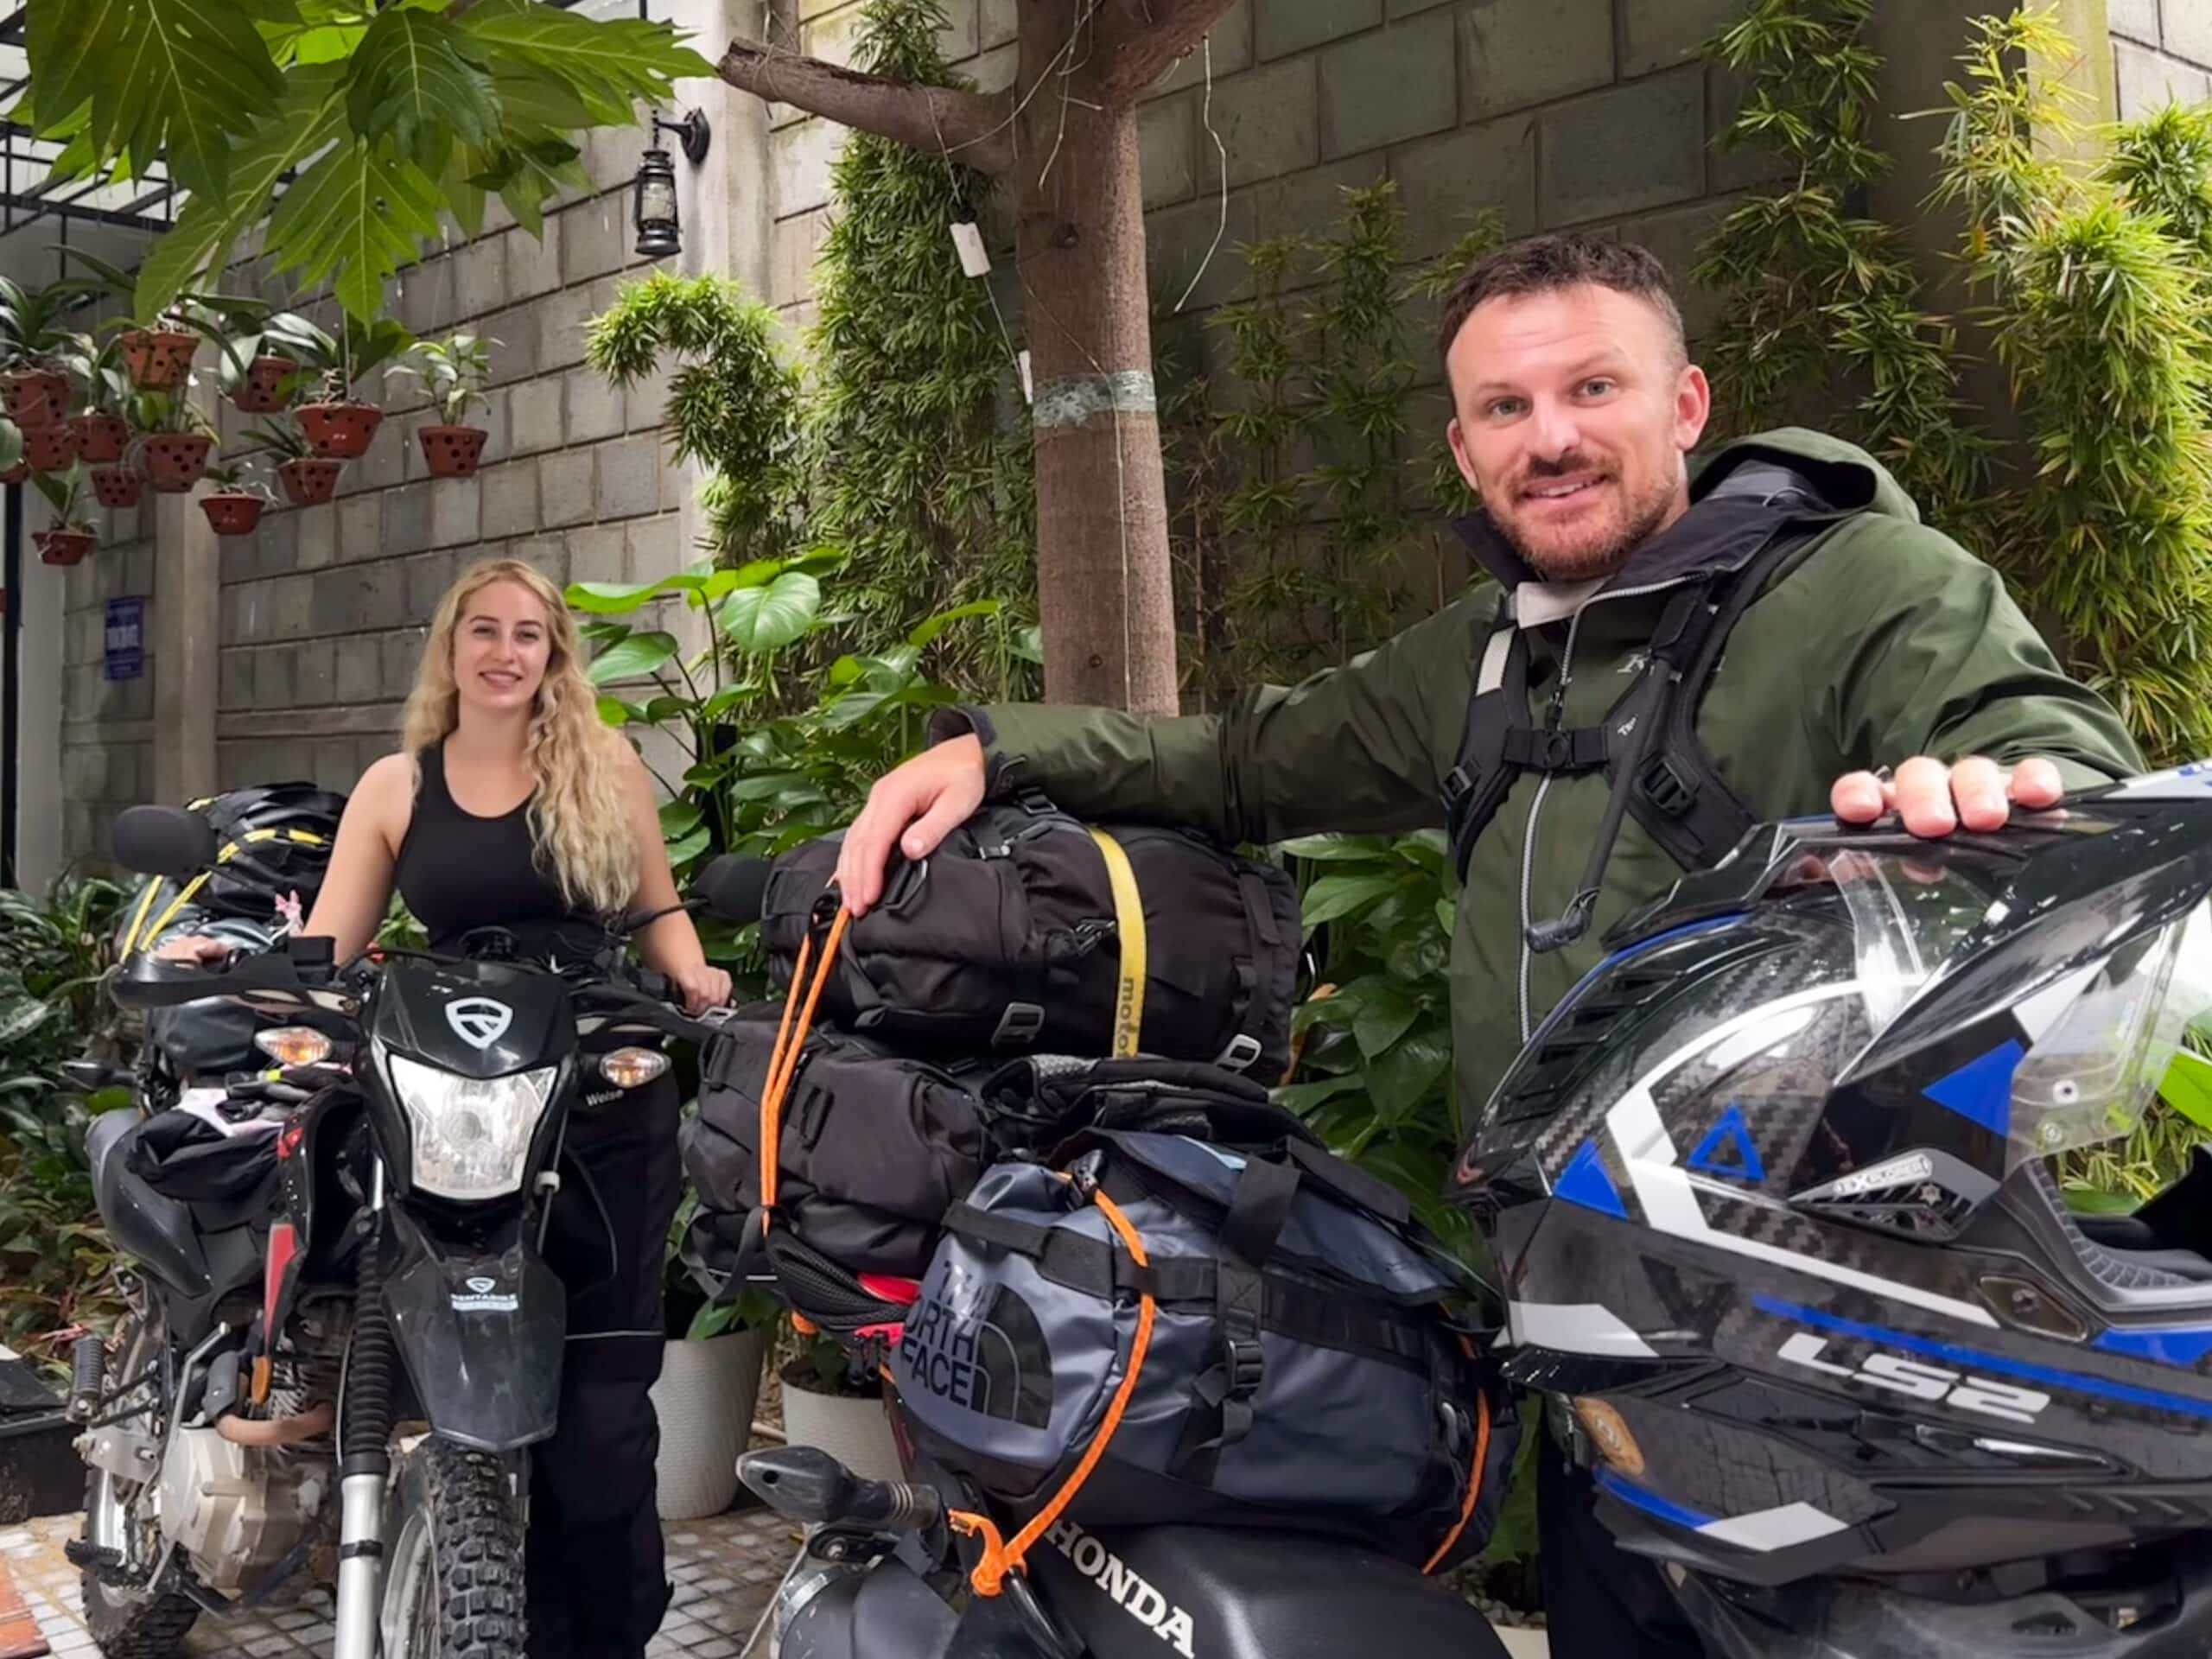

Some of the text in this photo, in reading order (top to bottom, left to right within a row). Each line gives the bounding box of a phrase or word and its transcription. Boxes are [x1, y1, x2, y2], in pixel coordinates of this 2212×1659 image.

[900, 1336, 973, 1408] FACE
[1777, 1332, 2051, 1425] LS2
[1043, 1518, 1196, 1659] HONDA
